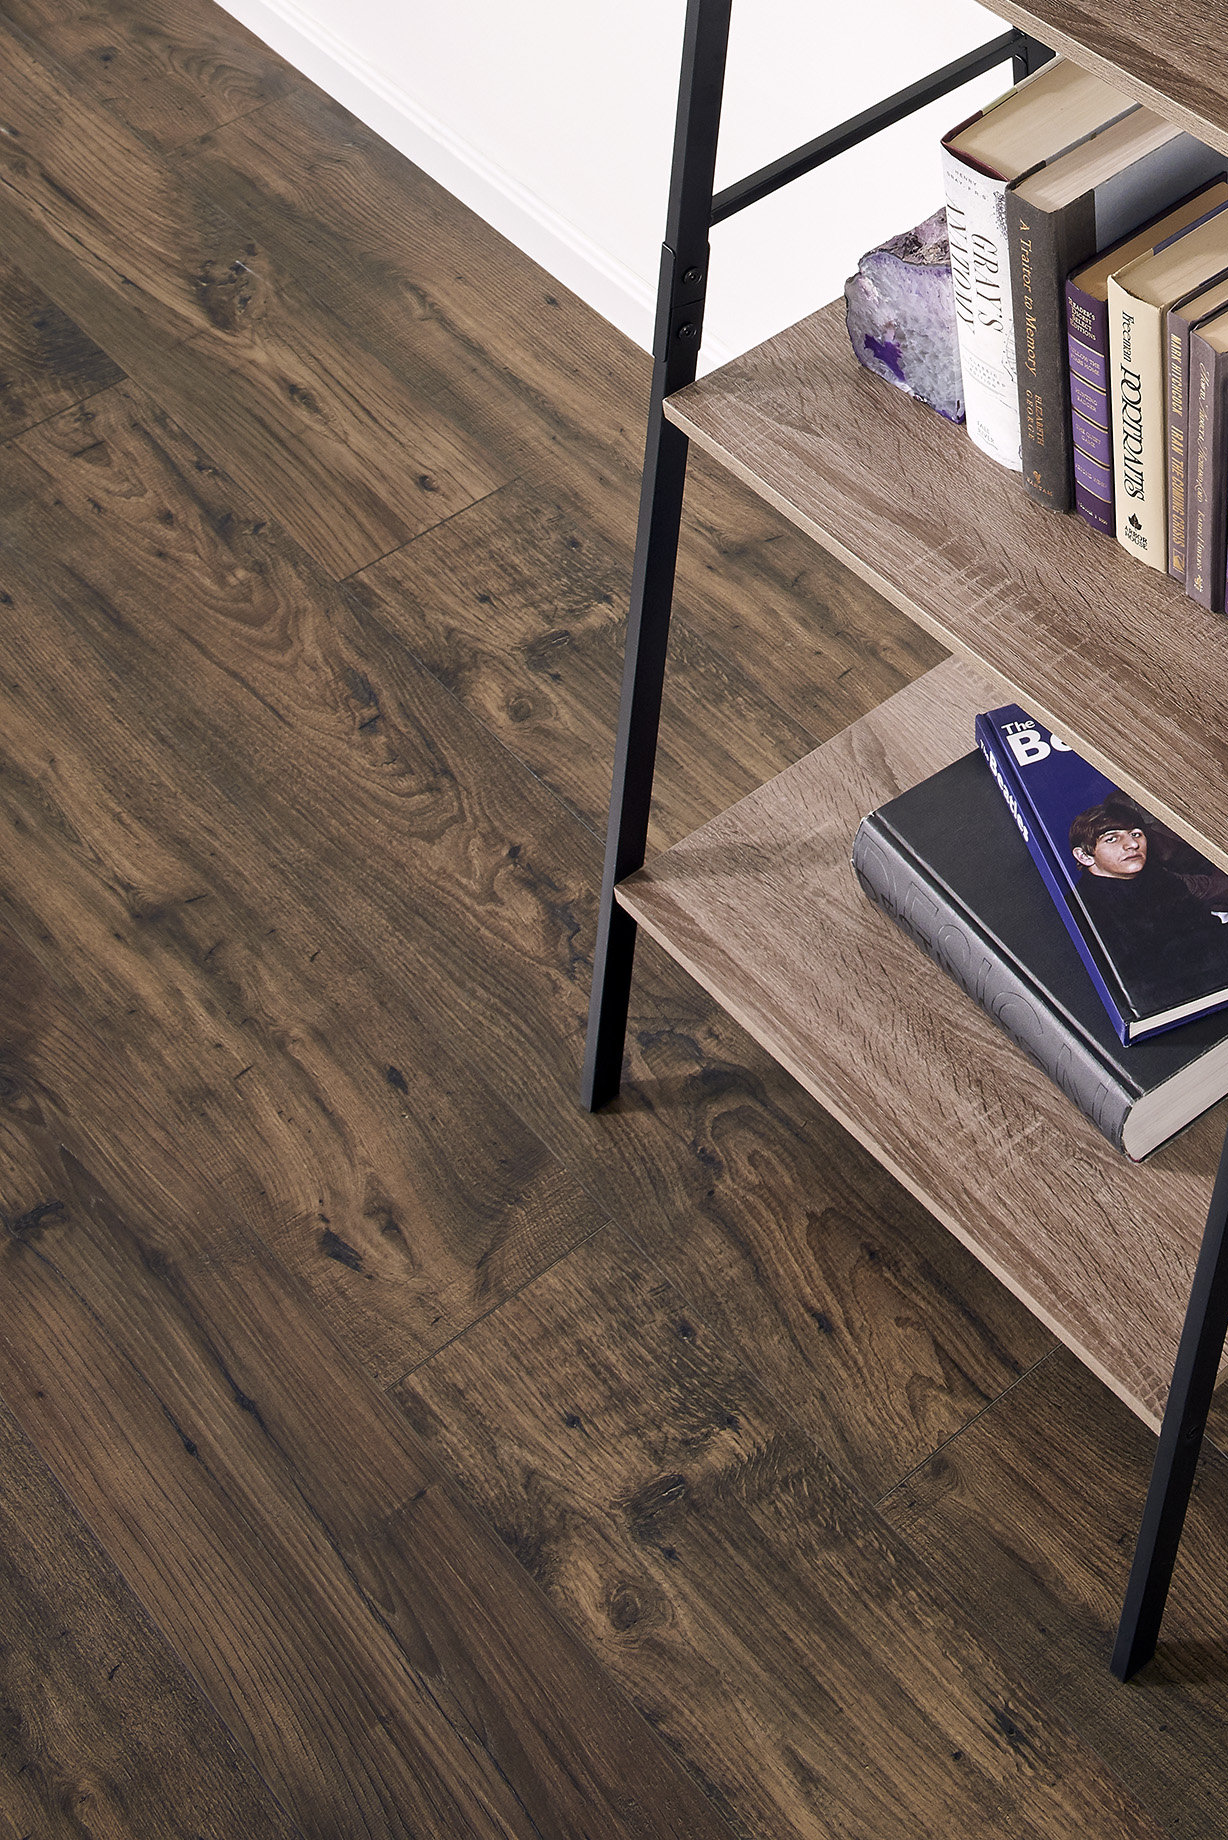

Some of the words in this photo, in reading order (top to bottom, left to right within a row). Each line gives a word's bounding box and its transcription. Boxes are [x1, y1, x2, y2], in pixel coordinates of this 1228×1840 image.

[1018, 218, 1031, 232] A
[945, 193, 976, 335] ANATOMY
[971, 233, 1004, 333] GRAY'S
[1019, 238, 1033, 294] Traitor
[1023, 294, 1033, 310] to
[1025, 311, 1038, 378] Memory
[1170, 332, 1182, 364] MARK
[1171, 362, 1183, 417] HITCHCOCK
[1025, 389, 1035, 441] GEORGE
[1171, 425, 1184, 457] IRAN
[1171, 457, 1184, 479] THE
[1172, 476, 1185, 516] COMING
[1172, 514, 1185, 548] CRISIS
[1001, 720, 1036, 735] The
[989, 750, 1029, 843] Beatles
